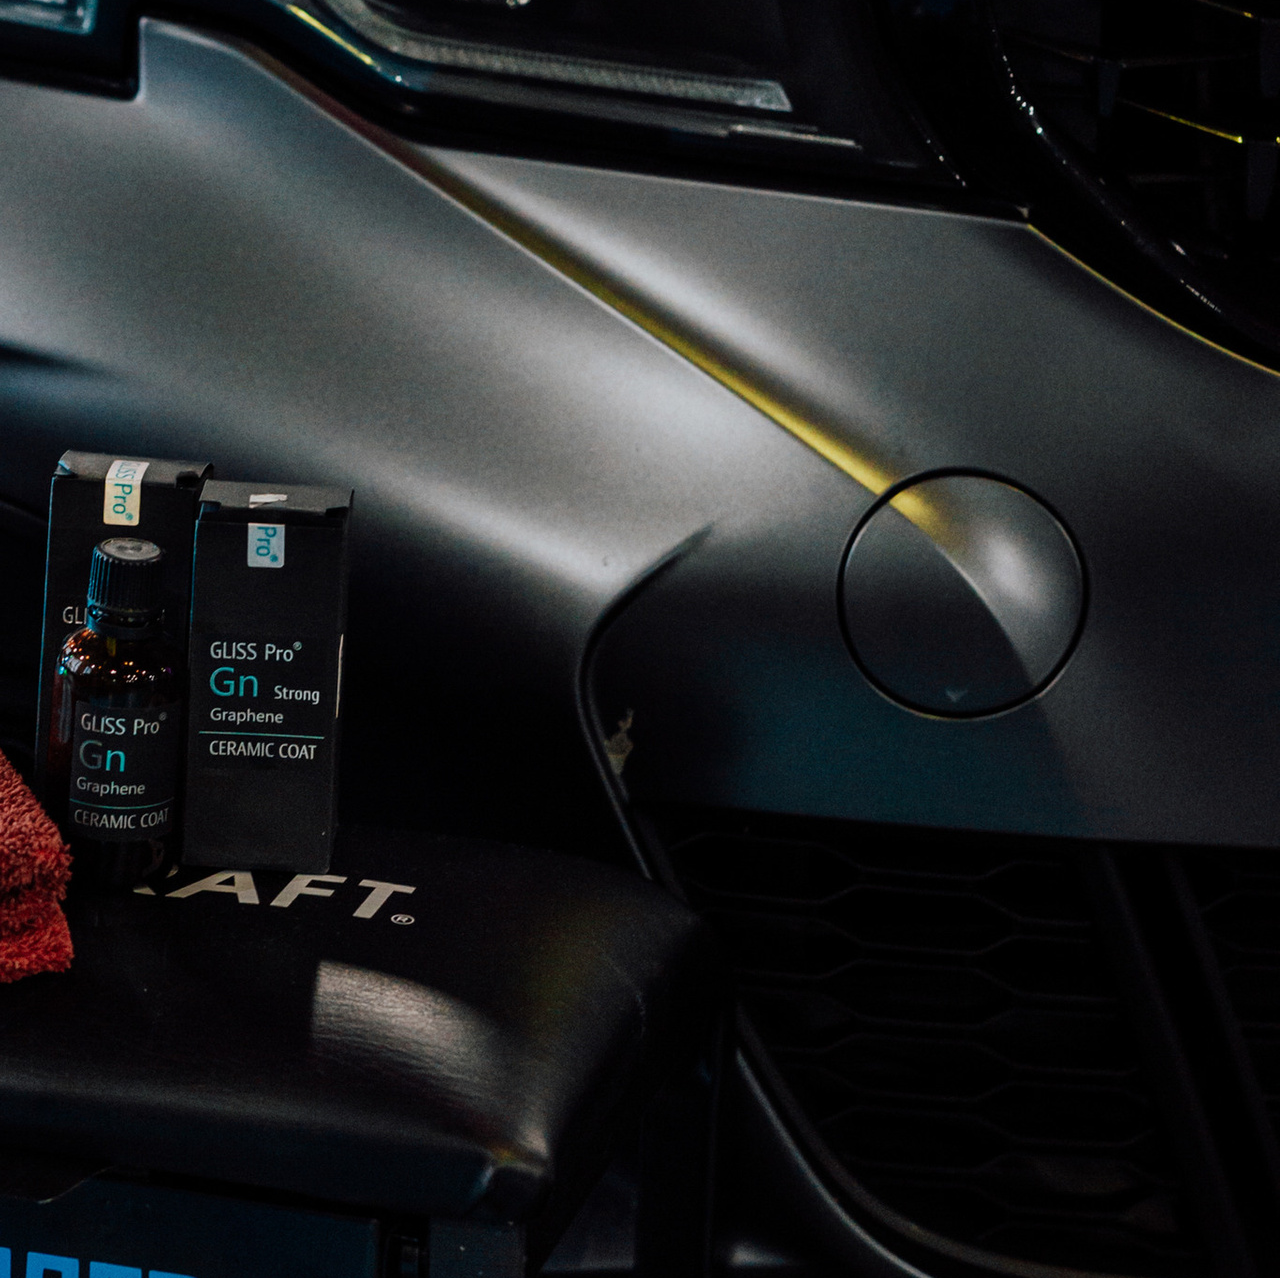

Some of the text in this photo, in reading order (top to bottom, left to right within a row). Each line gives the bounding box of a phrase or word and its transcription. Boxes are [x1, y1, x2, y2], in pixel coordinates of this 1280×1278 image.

[209, 641, 258, 660] GLISS
[209, 666, 320, 705] Gn Strong
[81, 713, 126, 735] GLISS
[210, 707, 284, 725] Graphene
[80, 739, 126, 772] Gn
[209, 740, 318, 760] CERAMIC COAT
[76, 776, 146, 797] Graphene
[74, 807, 170, 829] CERAMIC COAT
